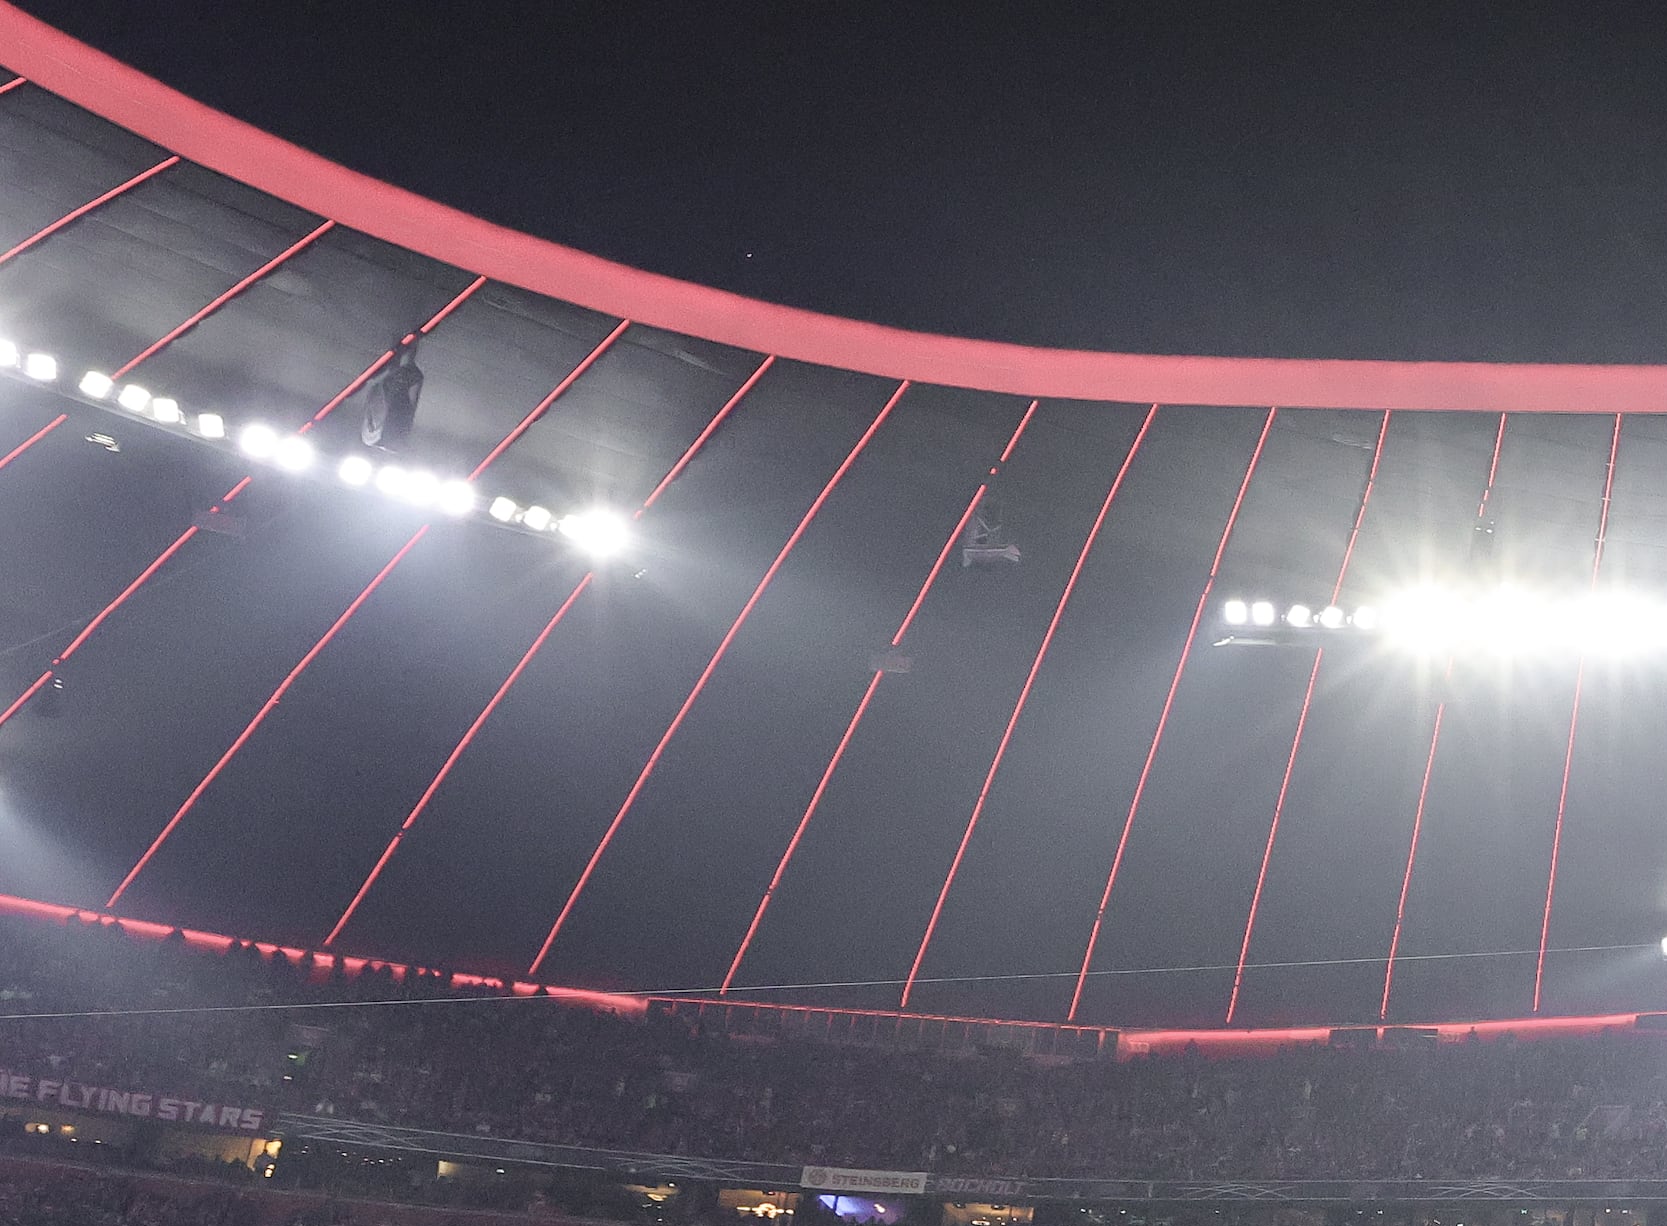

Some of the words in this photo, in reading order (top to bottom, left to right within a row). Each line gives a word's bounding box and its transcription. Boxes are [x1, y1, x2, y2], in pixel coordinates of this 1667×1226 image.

[37, 1078, 154, 1116] FLYING
[157, 1098, 264, 1130] STARS
[831, 1174, 920, 1190] STEINSBERG
